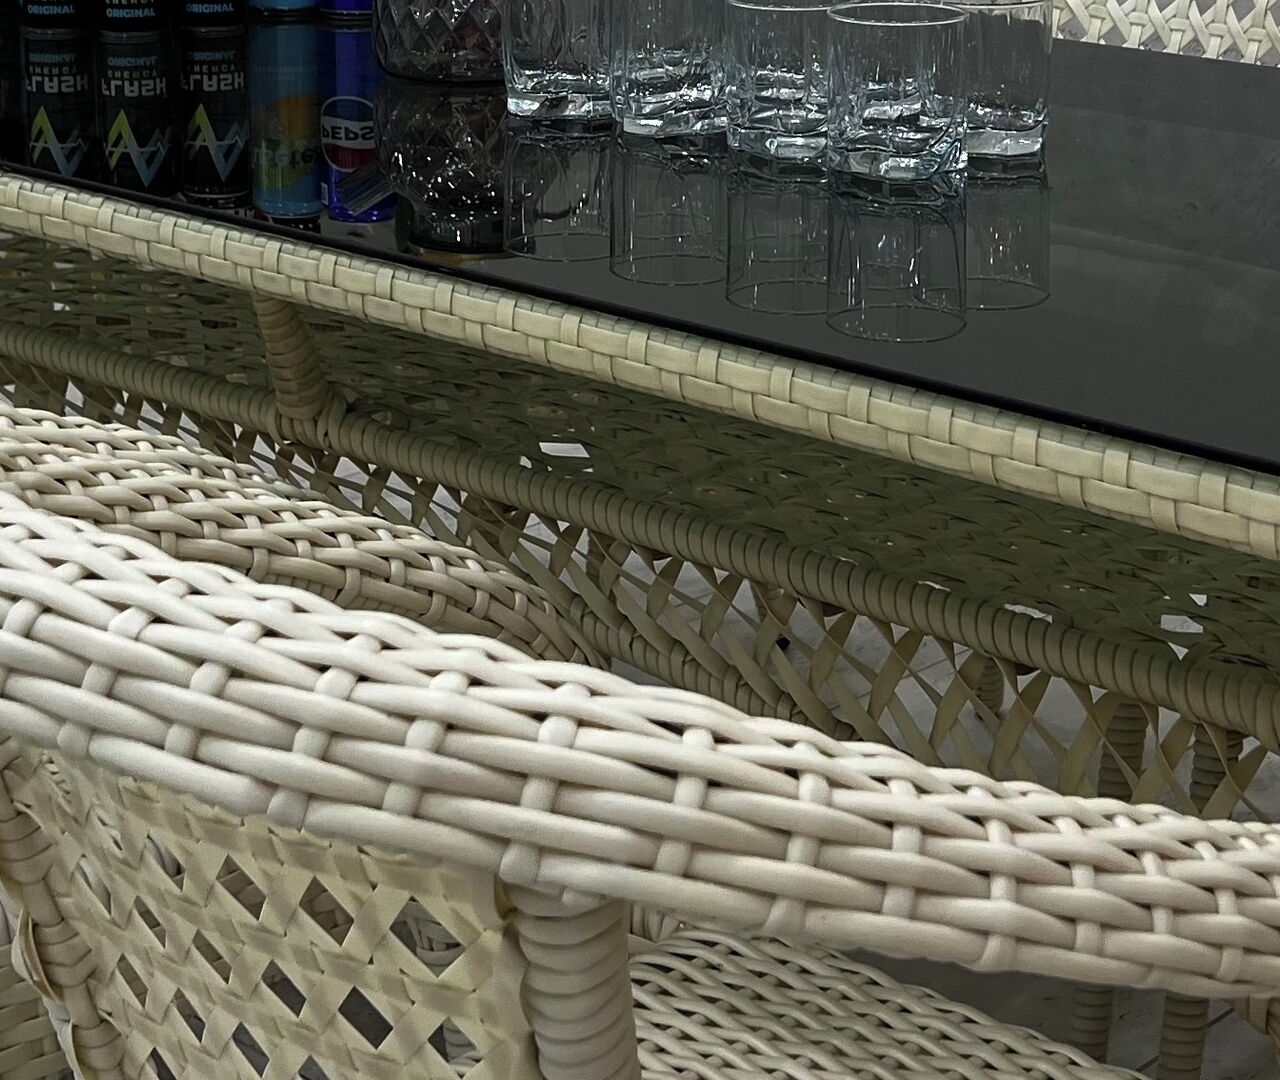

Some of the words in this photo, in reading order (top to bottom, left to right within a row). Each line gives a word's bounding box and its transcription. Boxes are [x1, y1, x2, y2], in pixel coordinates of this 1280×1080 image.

[27, 4, 75, 15] ORIGINAL
[106, 7, 157, 18] ORIGINAL
[186, 3, 235, 14] ORIGINAL
